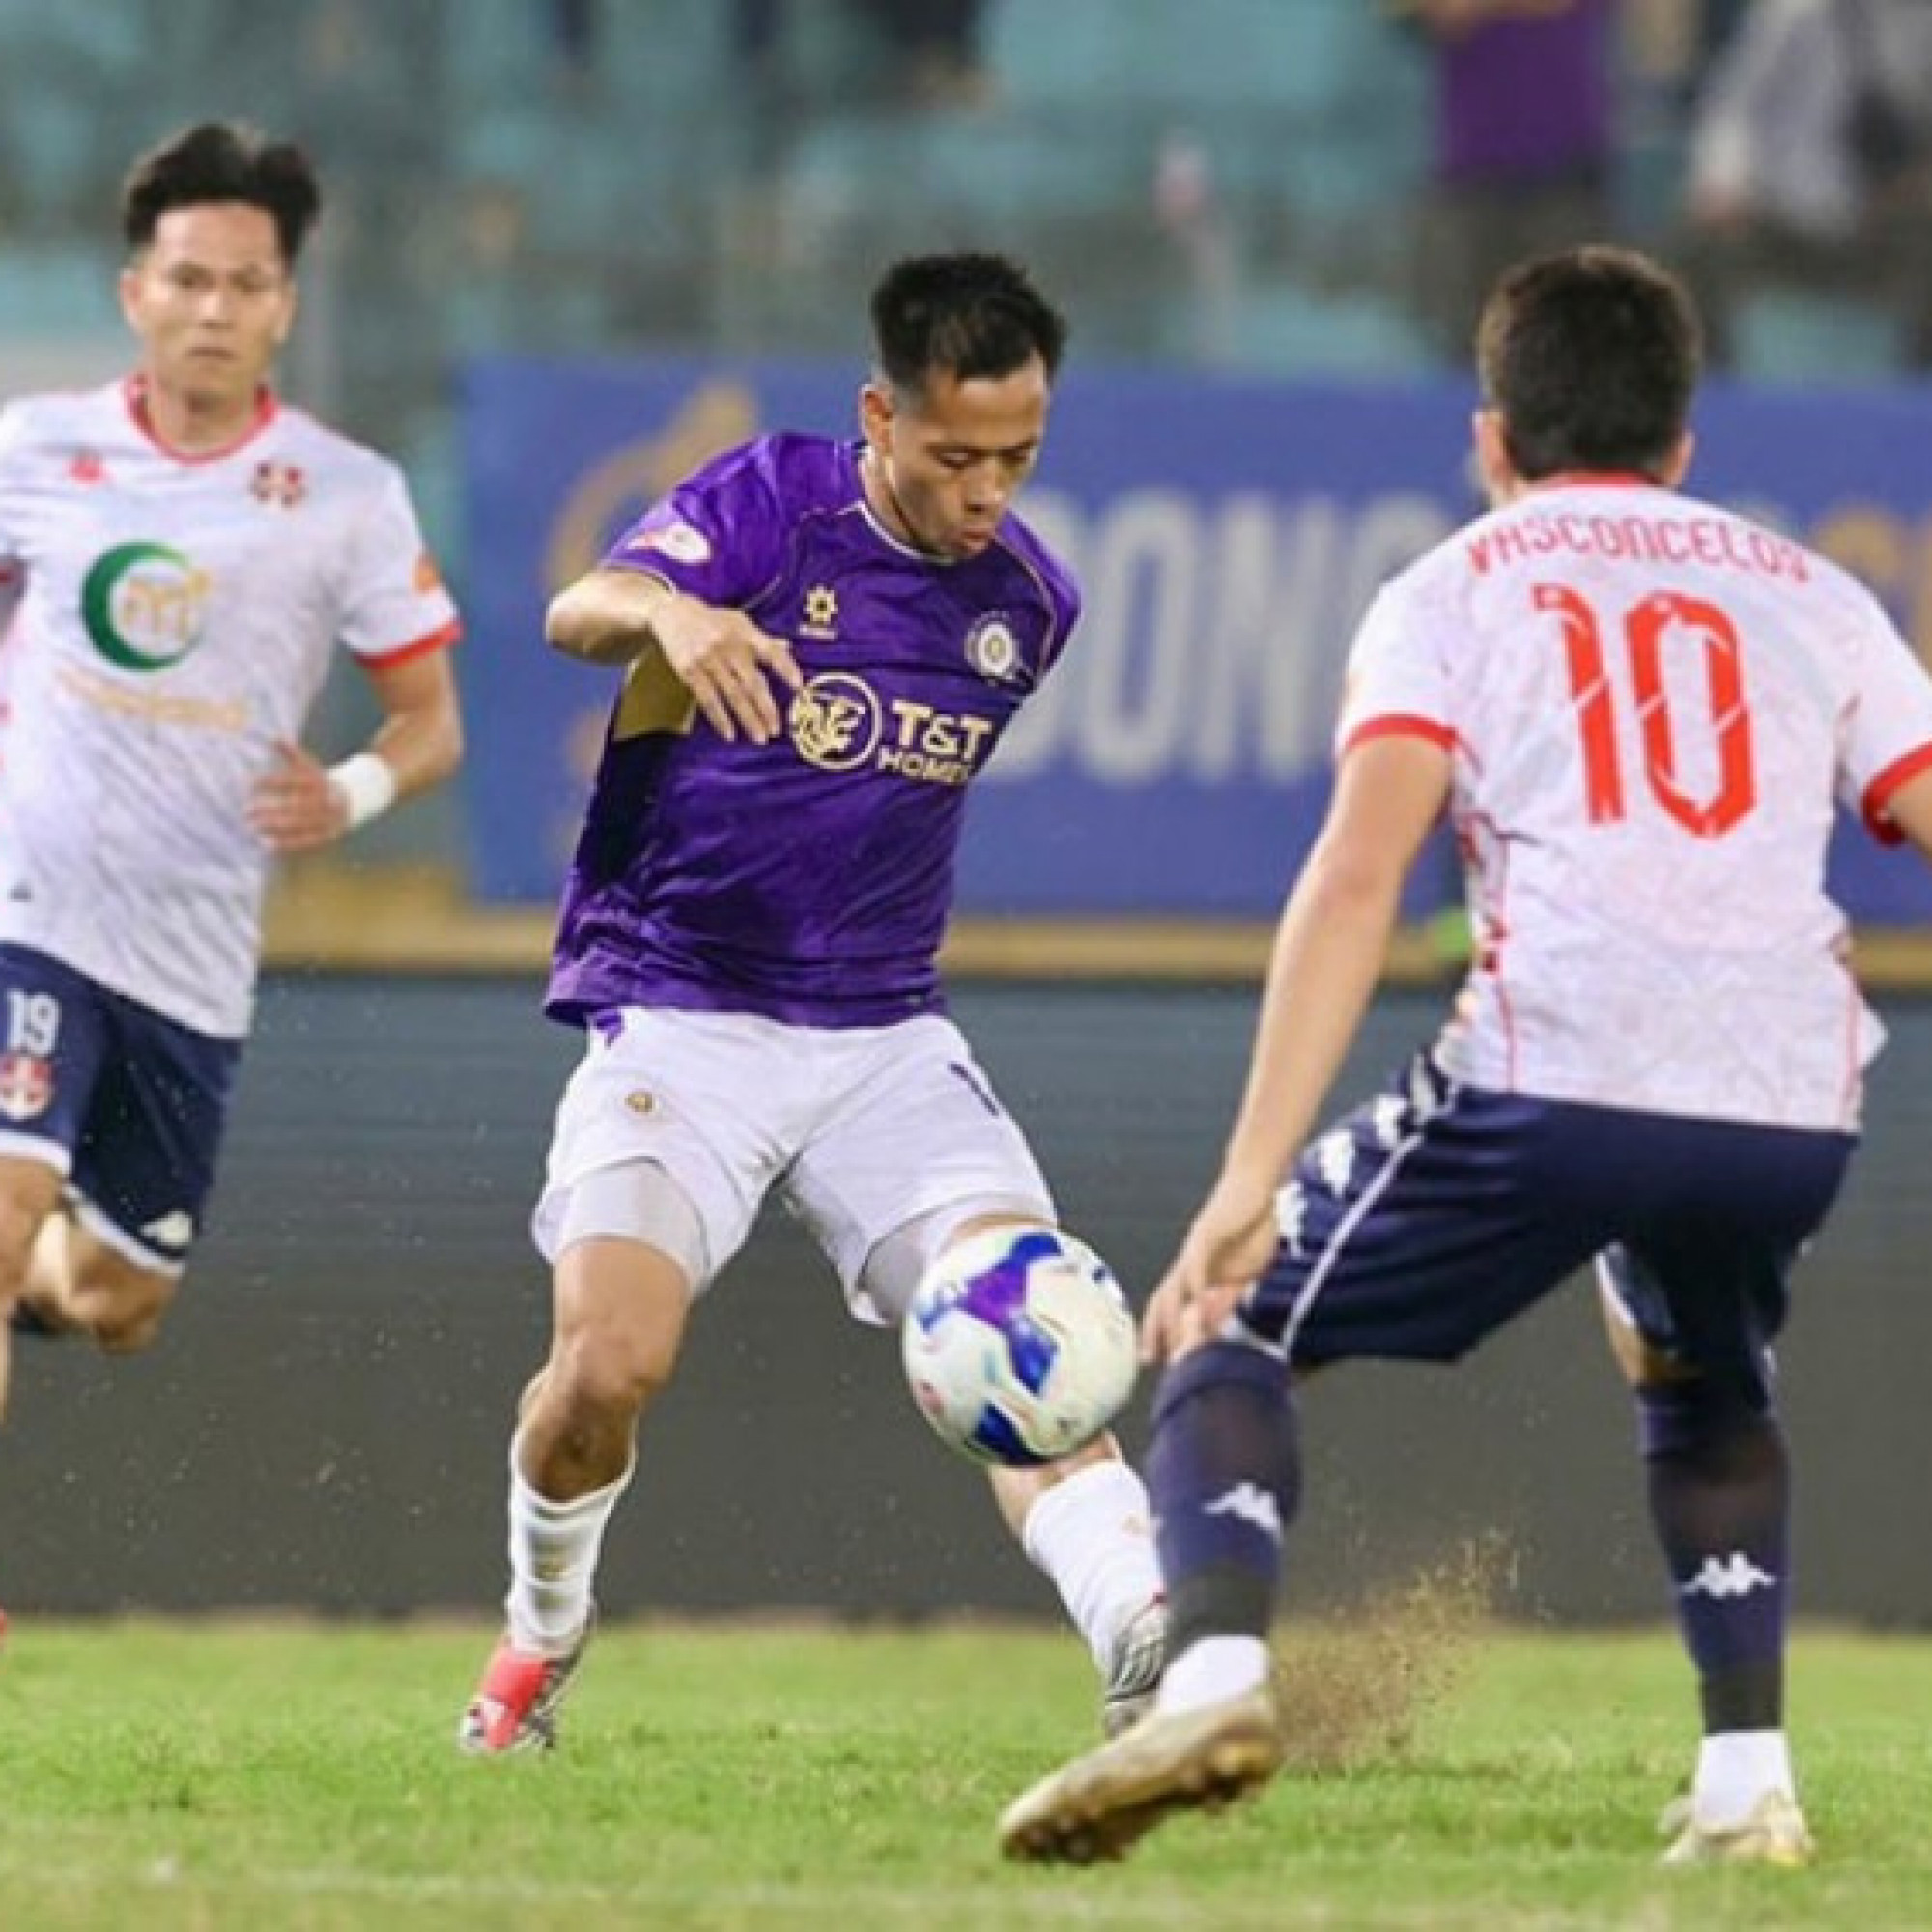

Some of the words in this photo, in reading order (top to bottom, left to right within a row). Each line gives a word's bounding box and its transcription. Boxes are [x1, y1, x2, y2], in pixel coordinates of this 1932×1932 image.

[890, 698, 994, 761] T&T
[1532, 582, 1757, 838] 10
[7, 988, 61, 1055] 19
